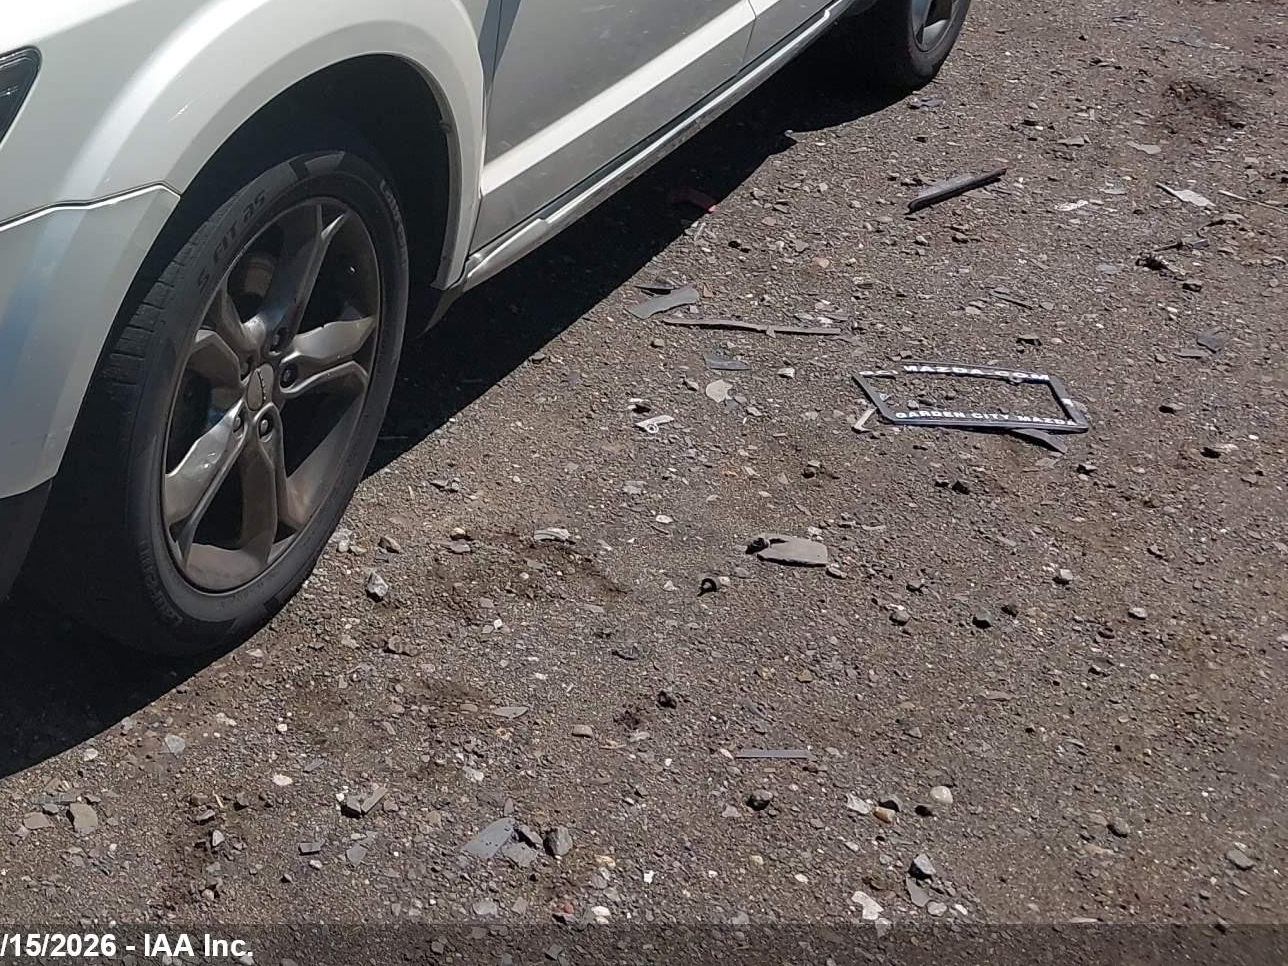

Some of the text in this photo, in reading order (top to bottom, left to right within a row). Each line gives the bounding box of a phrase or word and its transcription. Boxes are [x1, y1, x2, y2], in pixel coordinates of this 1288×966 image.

[895, 410, 1078, 426] GARDEN CITY MAZDA
